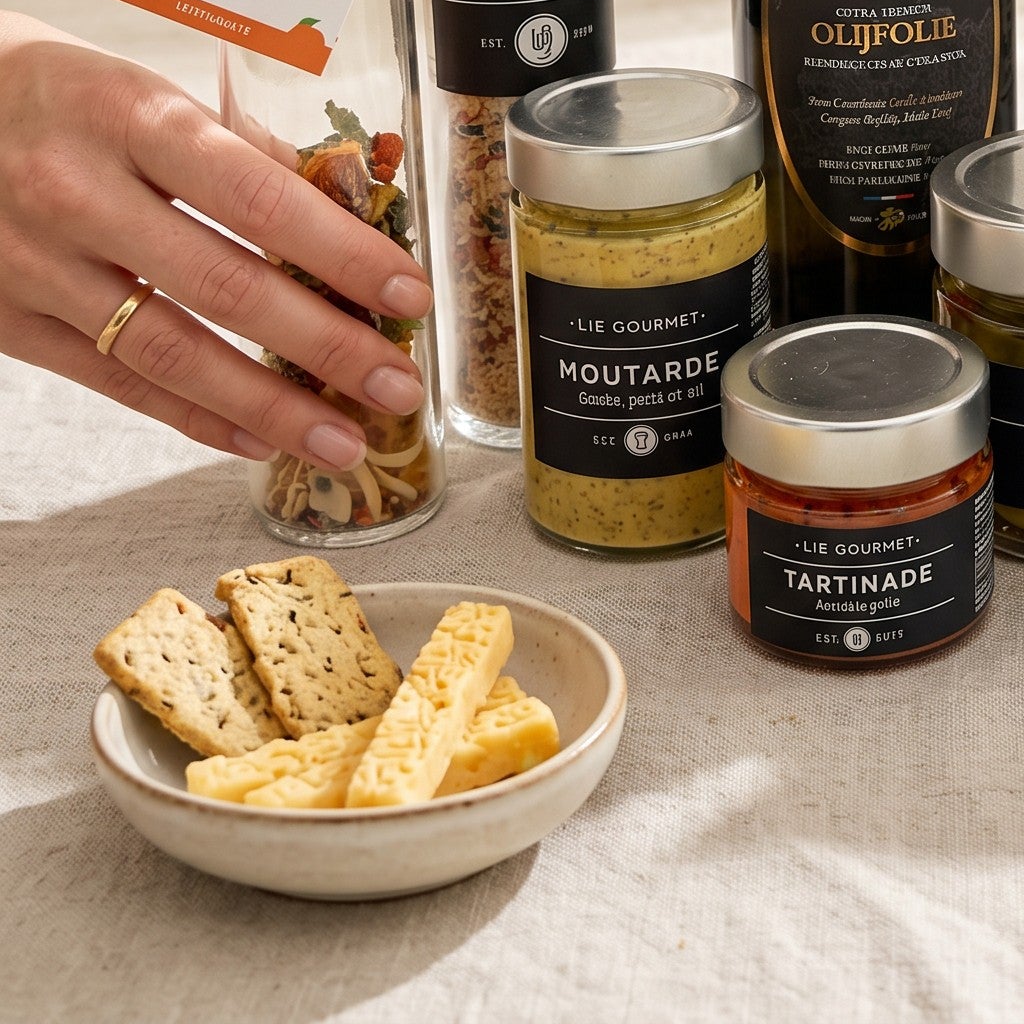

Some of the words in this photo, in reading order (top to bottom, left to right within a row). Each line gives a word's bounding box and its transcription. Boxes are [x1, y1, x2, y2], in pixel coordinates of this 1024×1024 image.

[481, 38, 506, 48] EST.
[811, 15, 957, 56] OLIJFOLIE
[559, 350, 720, 386] MOUTARDE
[783, 563, 933, 595] TARTINADE
